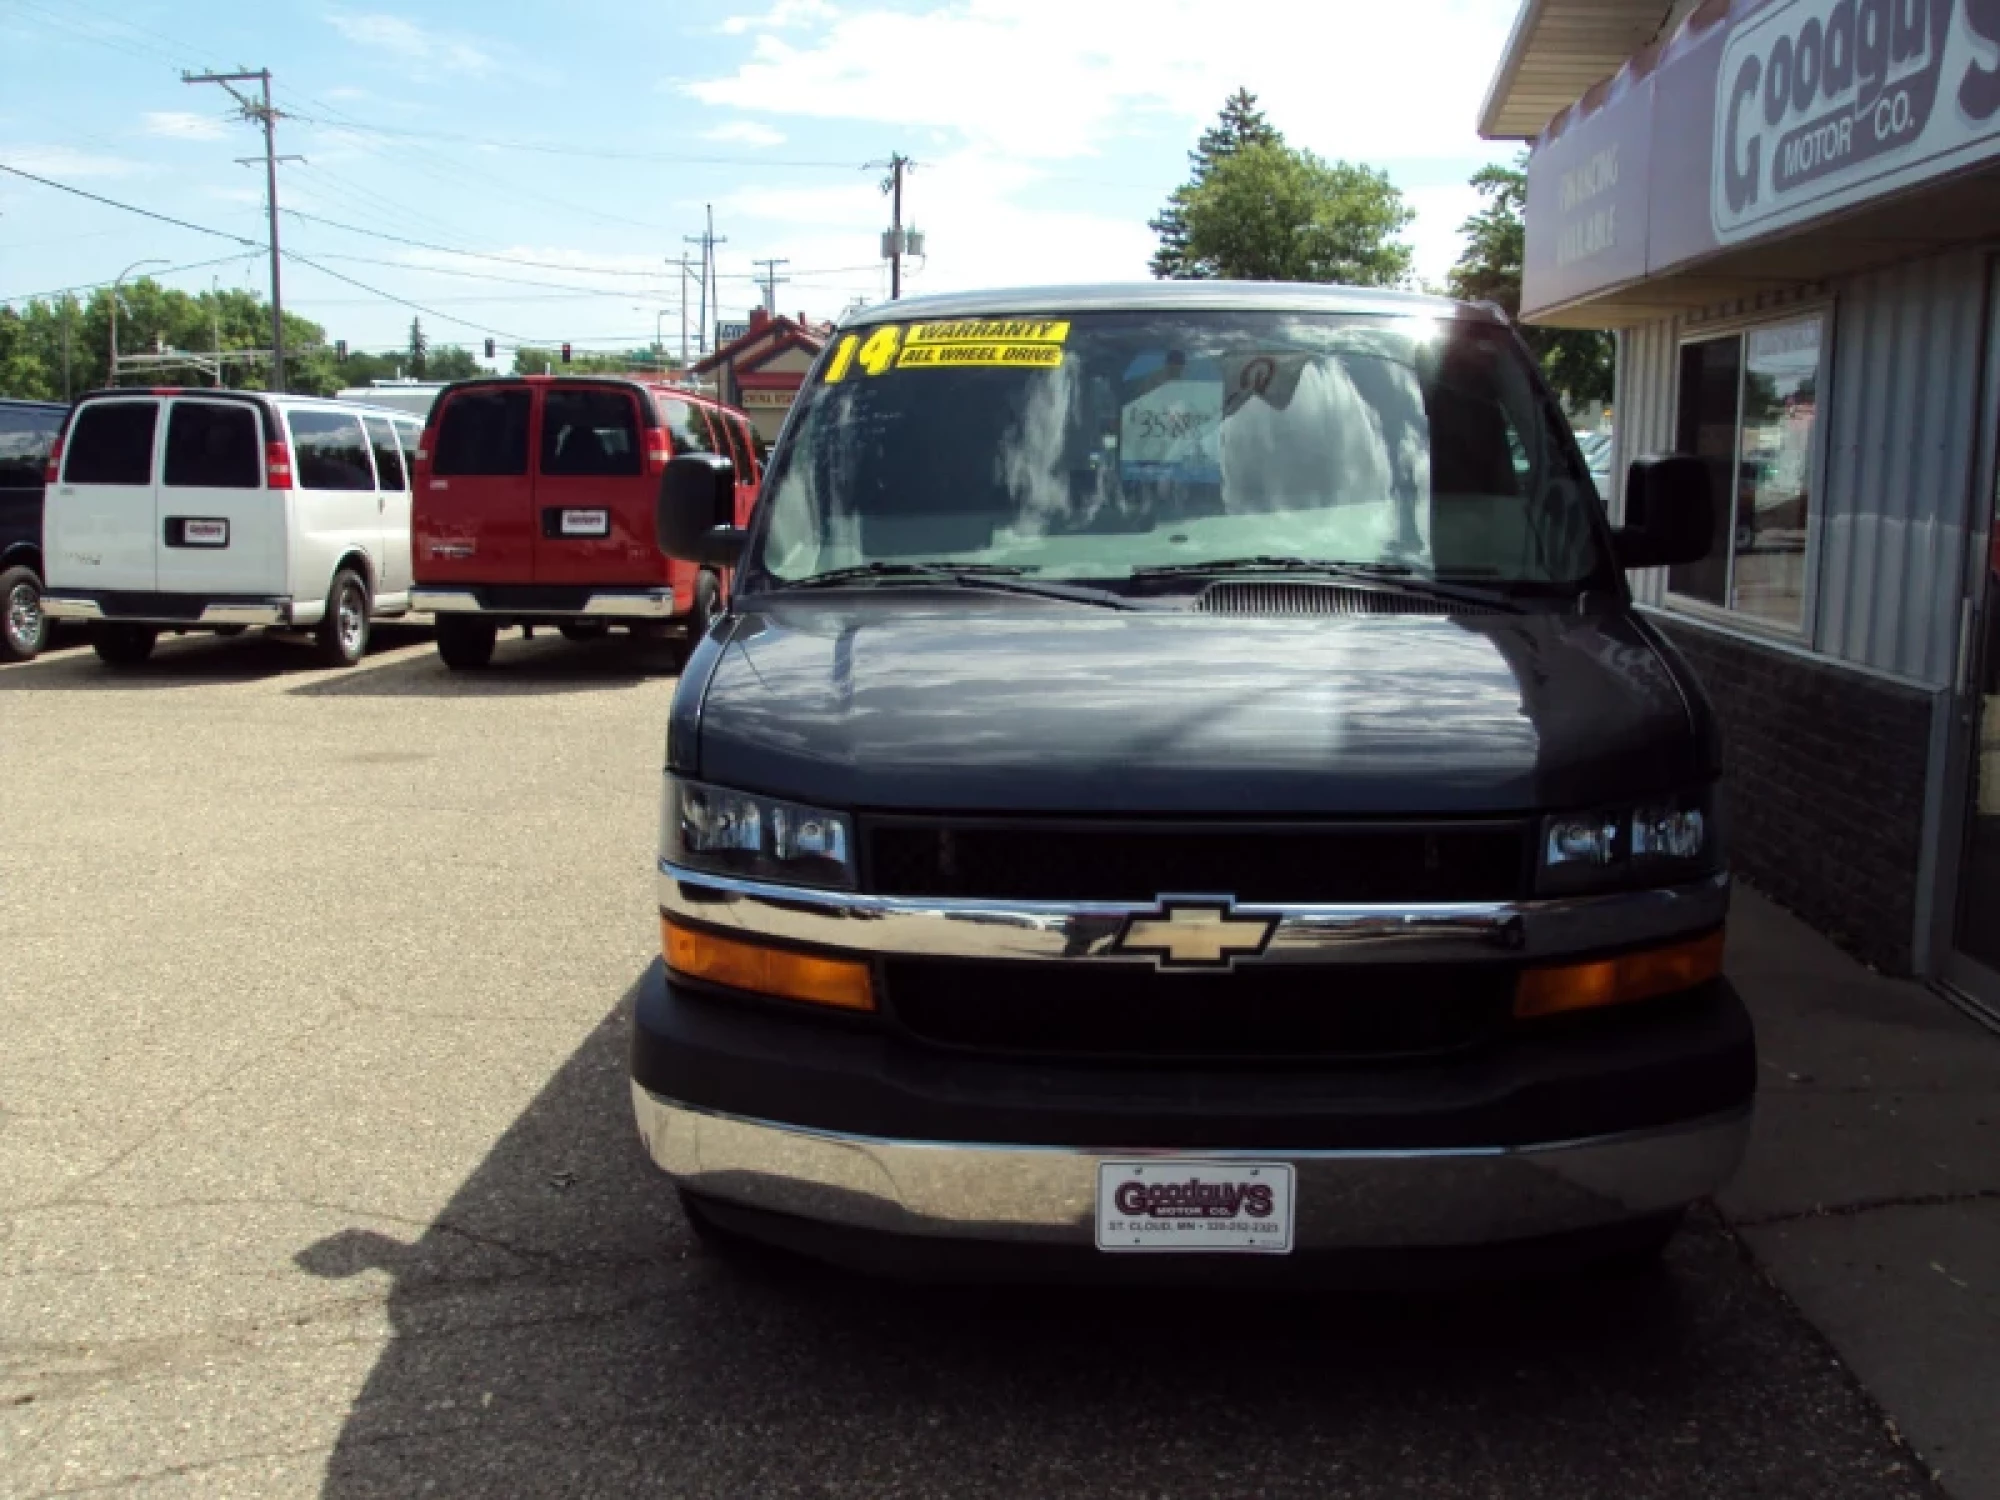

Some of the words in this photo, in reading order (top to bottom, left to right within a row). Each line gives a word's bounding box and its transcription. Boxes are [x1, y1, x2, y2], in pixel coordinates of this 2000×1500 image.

[1784, 116, 1852, 177] MOTOR
[1874, 90, 1915, 141] CO.
[916, 321, 1055, 341] WARRANTY
[825, 324, 901, 383] 14
[902, 347, 935, 362] ALL
[938, 347, 997, 362] WHEEL
[1001, 347, 1057, 362] DRIVE
[1156, 1206, 1203, 1216] MOTOR
[1177, 1221, 1196, 1231] MN
